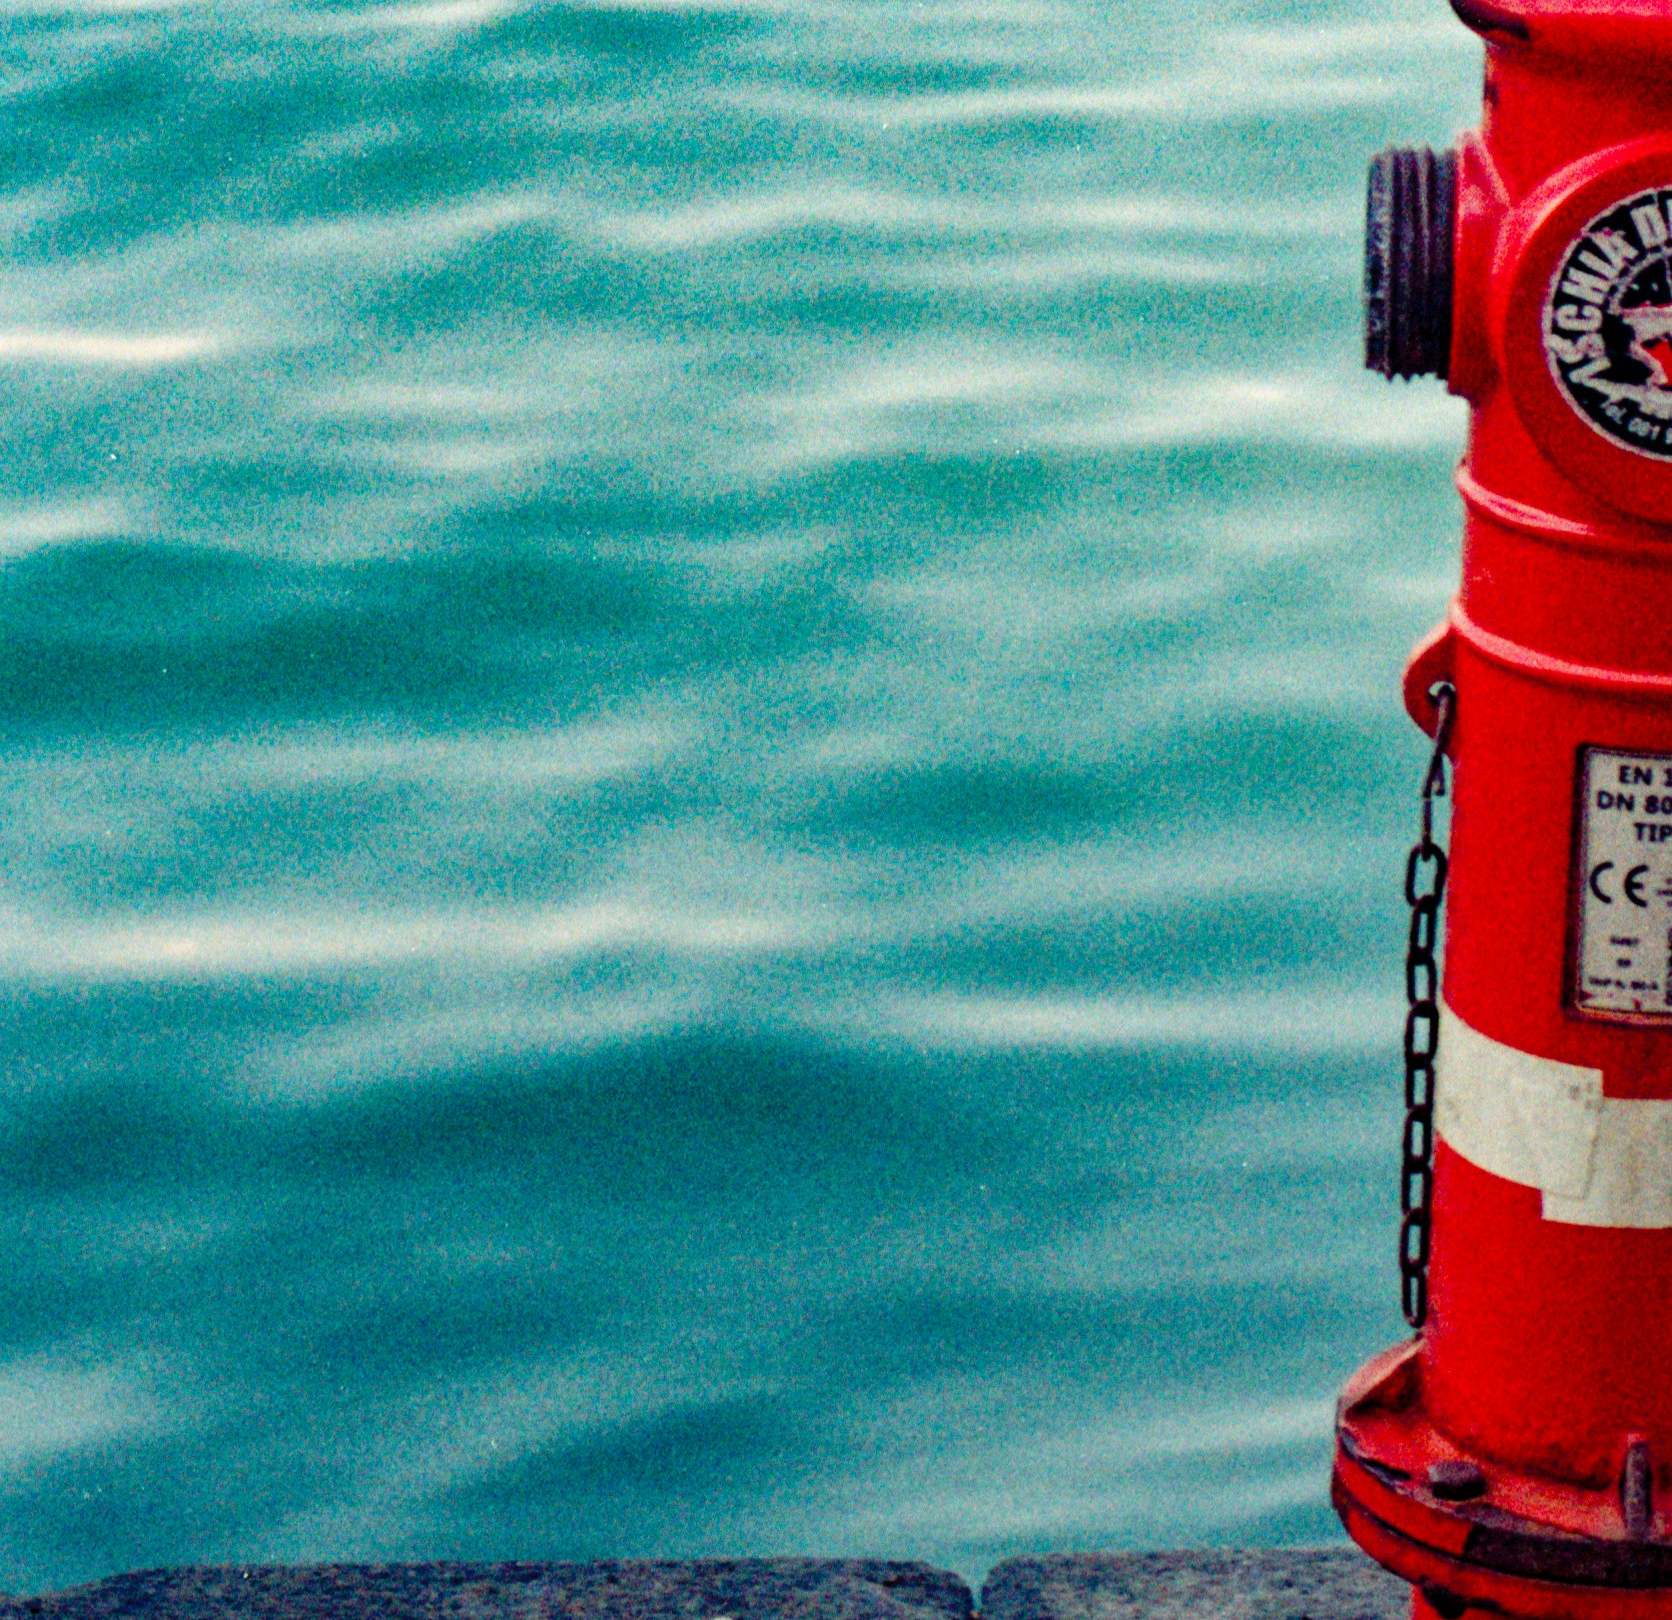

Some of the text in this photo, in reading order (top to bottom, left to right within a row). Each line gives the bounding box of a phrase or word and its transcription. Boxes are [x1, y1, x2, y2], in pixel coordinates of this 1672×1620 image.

[1551, 227, 1638, 385] ISCHIA
[1618, 764, 1653, 786] EN
[1596, 790, 1635, 813] DN
[1589, 861, 1650, 909] CE
